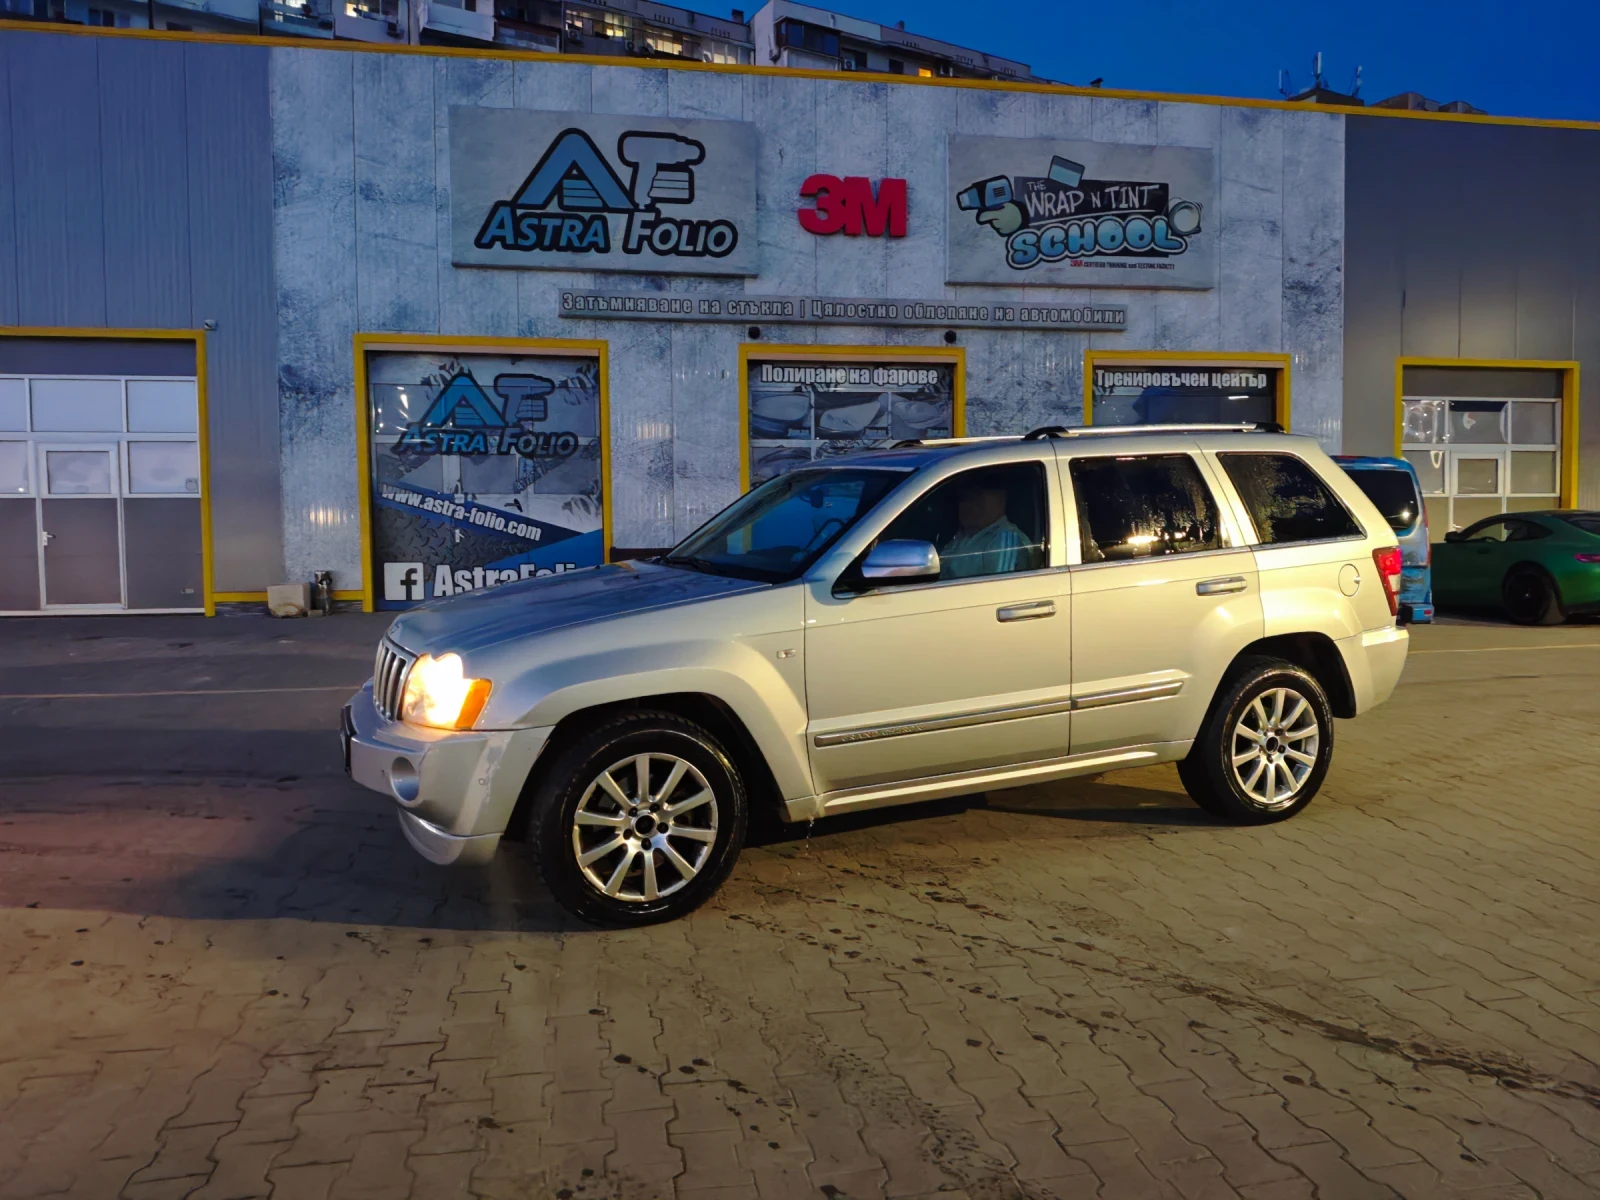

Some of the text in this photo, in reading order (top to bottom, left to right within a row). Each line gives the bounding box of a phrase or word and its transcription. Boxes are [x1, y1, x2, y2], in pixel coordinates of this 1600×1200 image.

[1024, 190, 1084, 217] WRAP
[1104, 184, 1160, 209] TINT
[1026, 180, 1046, 191] THE
[798, 174, 906, 237] 3M
[1008, 216, 1186, 267] SCHOOL
[562, 293, 1125, 324] Затъмняване на стъкла Цялостно облепяне на автомобили
[761, 364, 938, 386] Полиране на фарове
[1095, 369, 1267, 389] Тренировъчен център
[381, 484, 542, 541] www.astra-folio.com
[433, 563, 576, 597] AstraF
